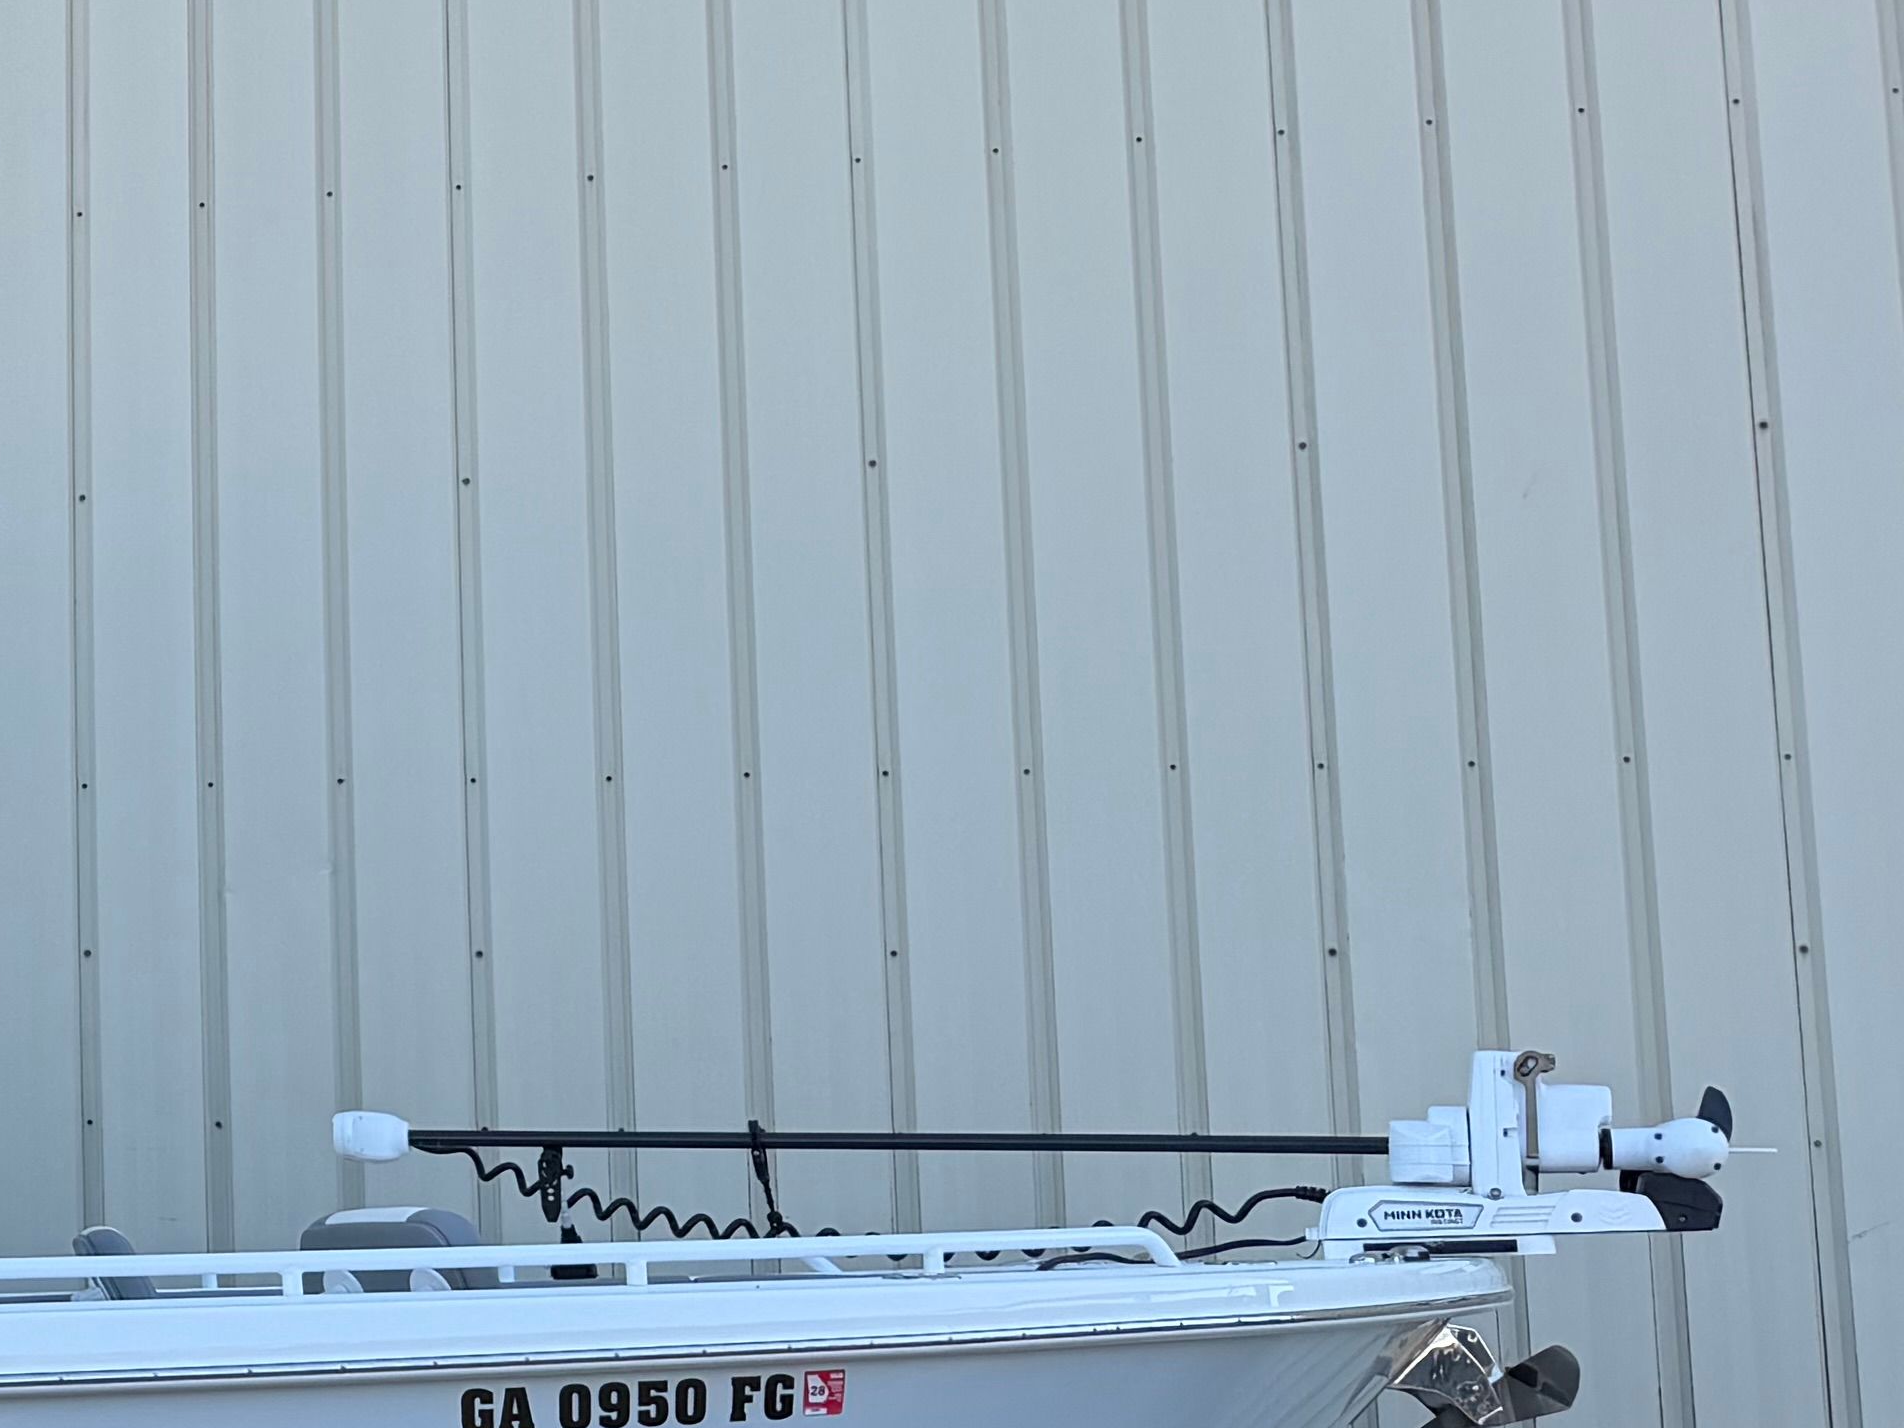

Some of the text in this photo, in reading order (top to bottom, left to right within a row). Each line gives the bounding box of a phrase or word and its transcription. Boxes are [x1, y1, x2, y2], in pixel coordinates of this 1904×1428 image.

[1383, 1208, 1463, 1220] MINN KOTA
[729, 1373, 795, 1422] FG
